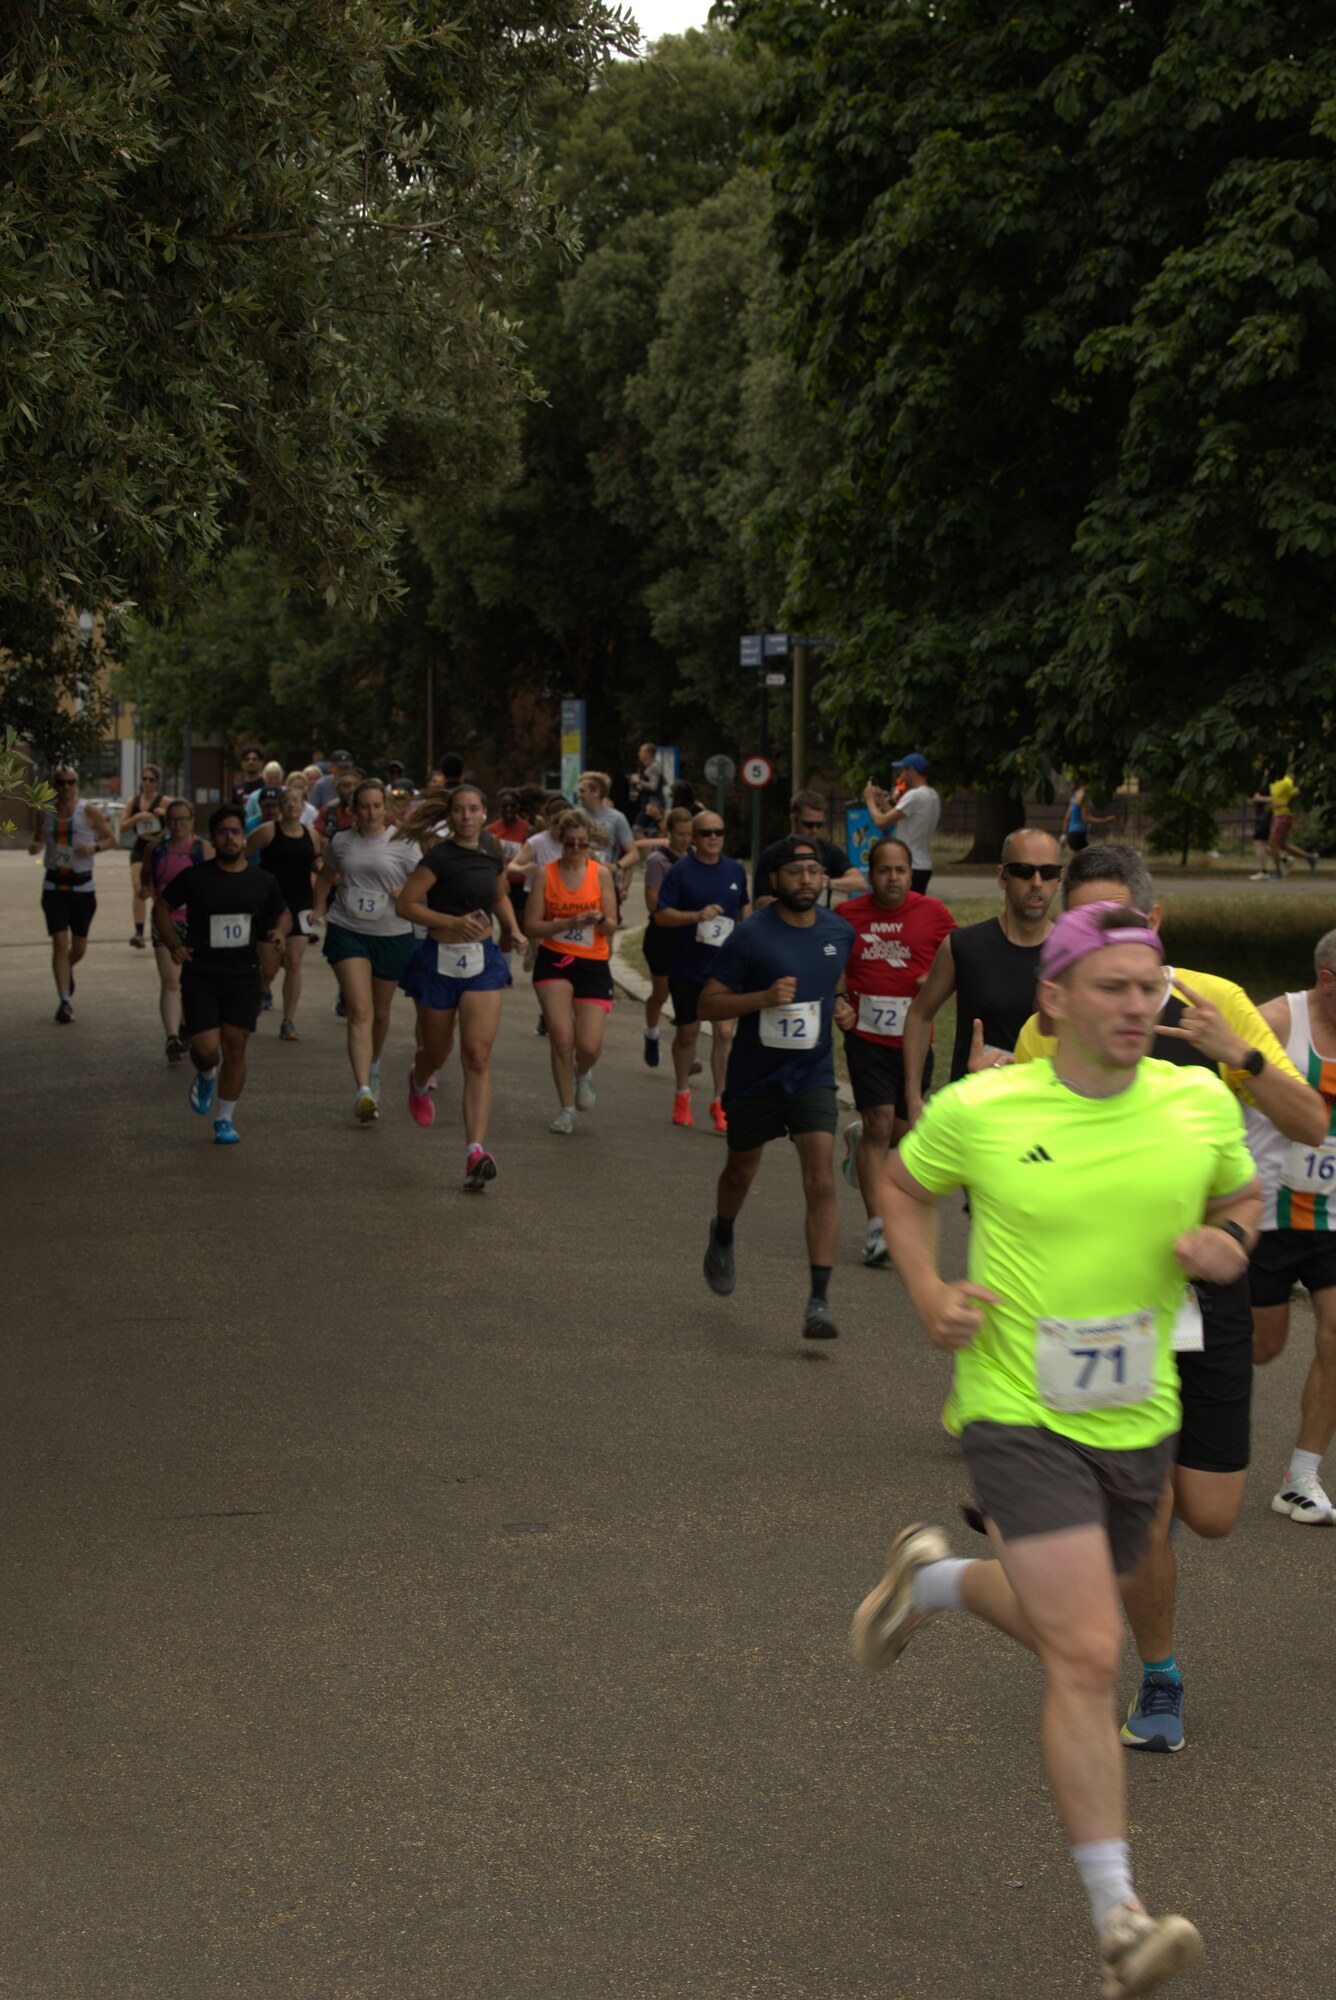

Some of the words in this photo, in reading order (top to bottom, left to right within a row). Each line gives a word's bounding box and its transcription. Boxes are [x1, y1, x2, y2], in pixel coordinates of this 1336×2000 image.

[753, 765, 761, 778] 5
[358, 898, 375, 912] 13
[223, 925, 242, 939] 10
[564, 928, 583, 941] 28
[712, 924, 721, 938] 3
[456, 954, 467, 969] 4
[872, 1008, 897, 1026] 72
[778, 1018, 806, 1038] 12
[1304, 1153, 1336, 1180] 16
[1070, 1345, 1124, 1389] 71
